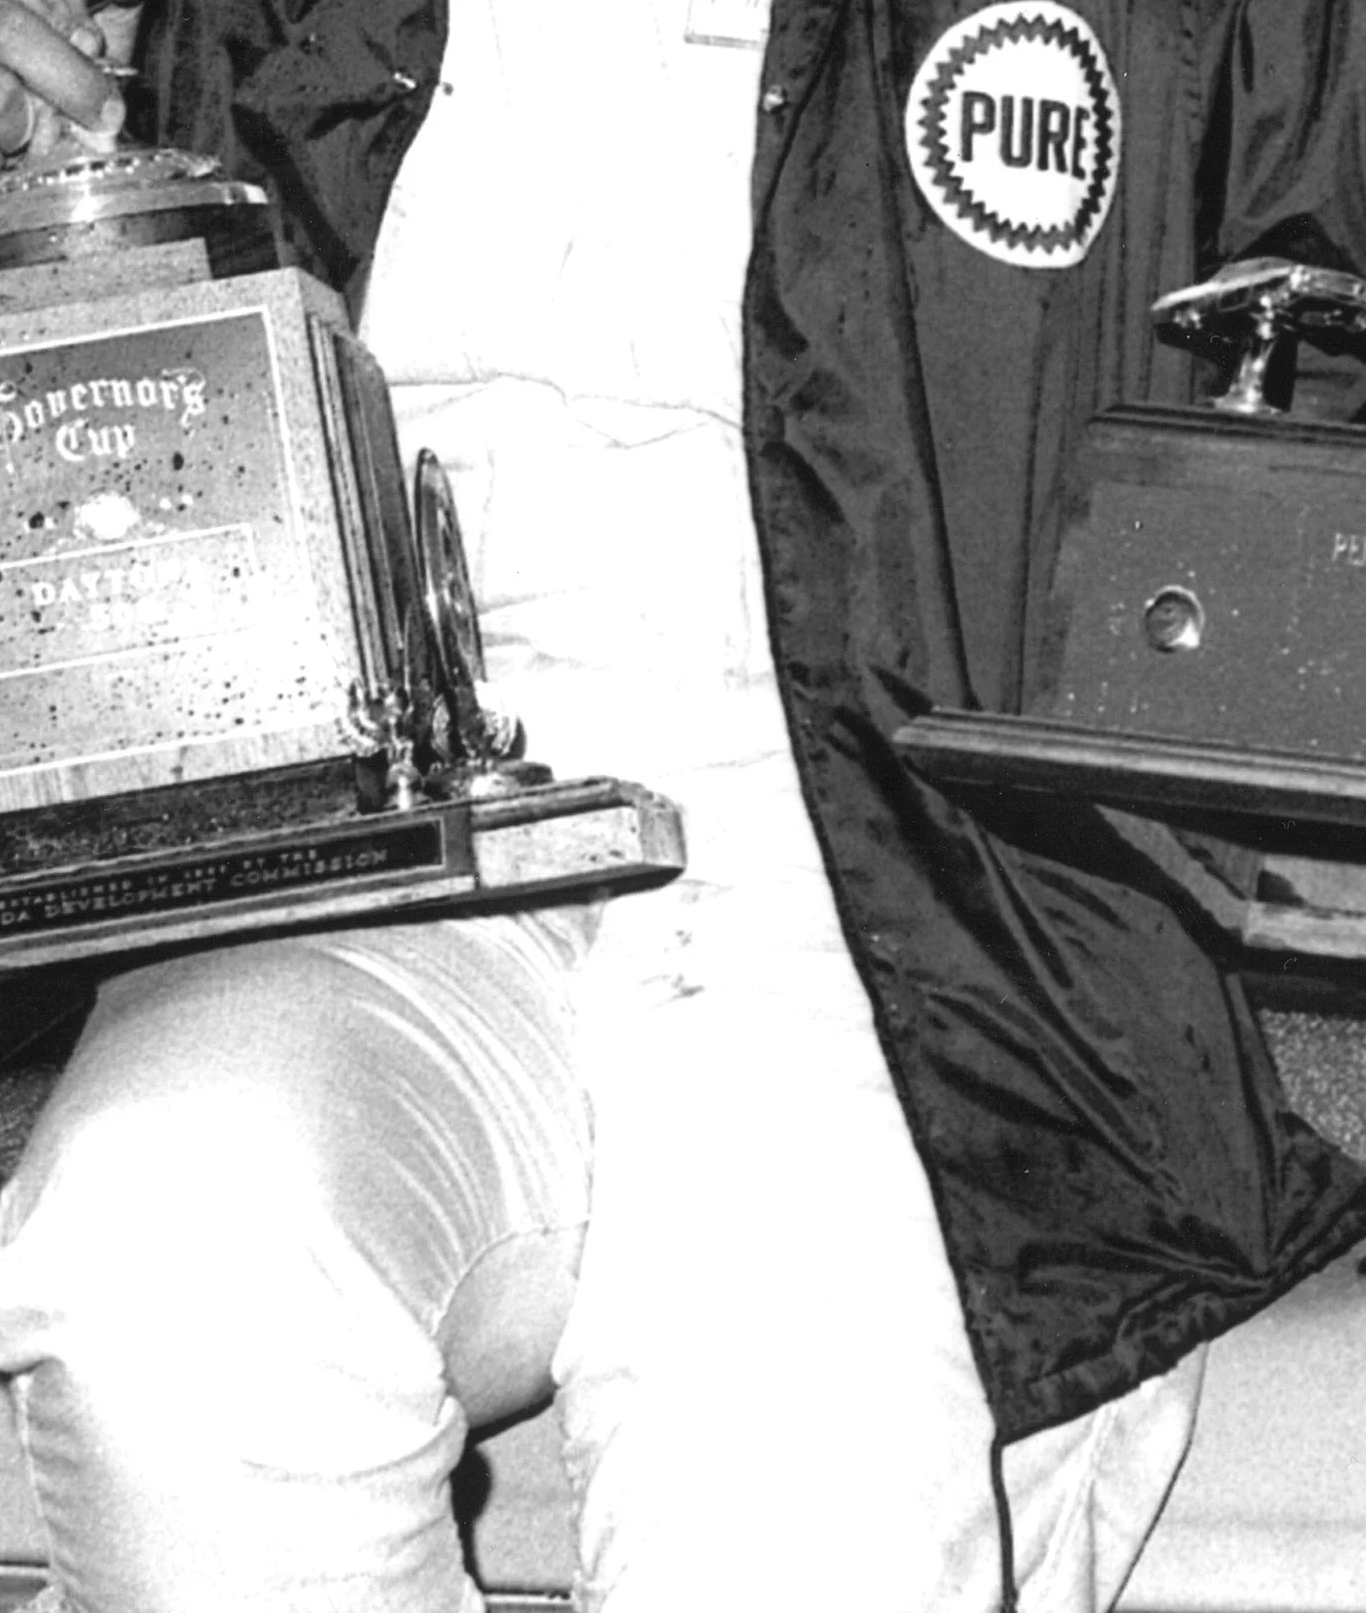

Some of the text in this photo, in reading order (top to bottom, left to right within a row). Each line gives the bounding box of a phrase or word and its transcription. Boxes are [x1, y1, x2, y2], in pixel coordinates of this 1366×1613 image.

[960, 90, 1091, 181] PURE
[55, 417, 136, 462] Cup
[44, 877, 218, 918] DEVELOPMENT
[230, 848, 388, 887] COMMISSION
